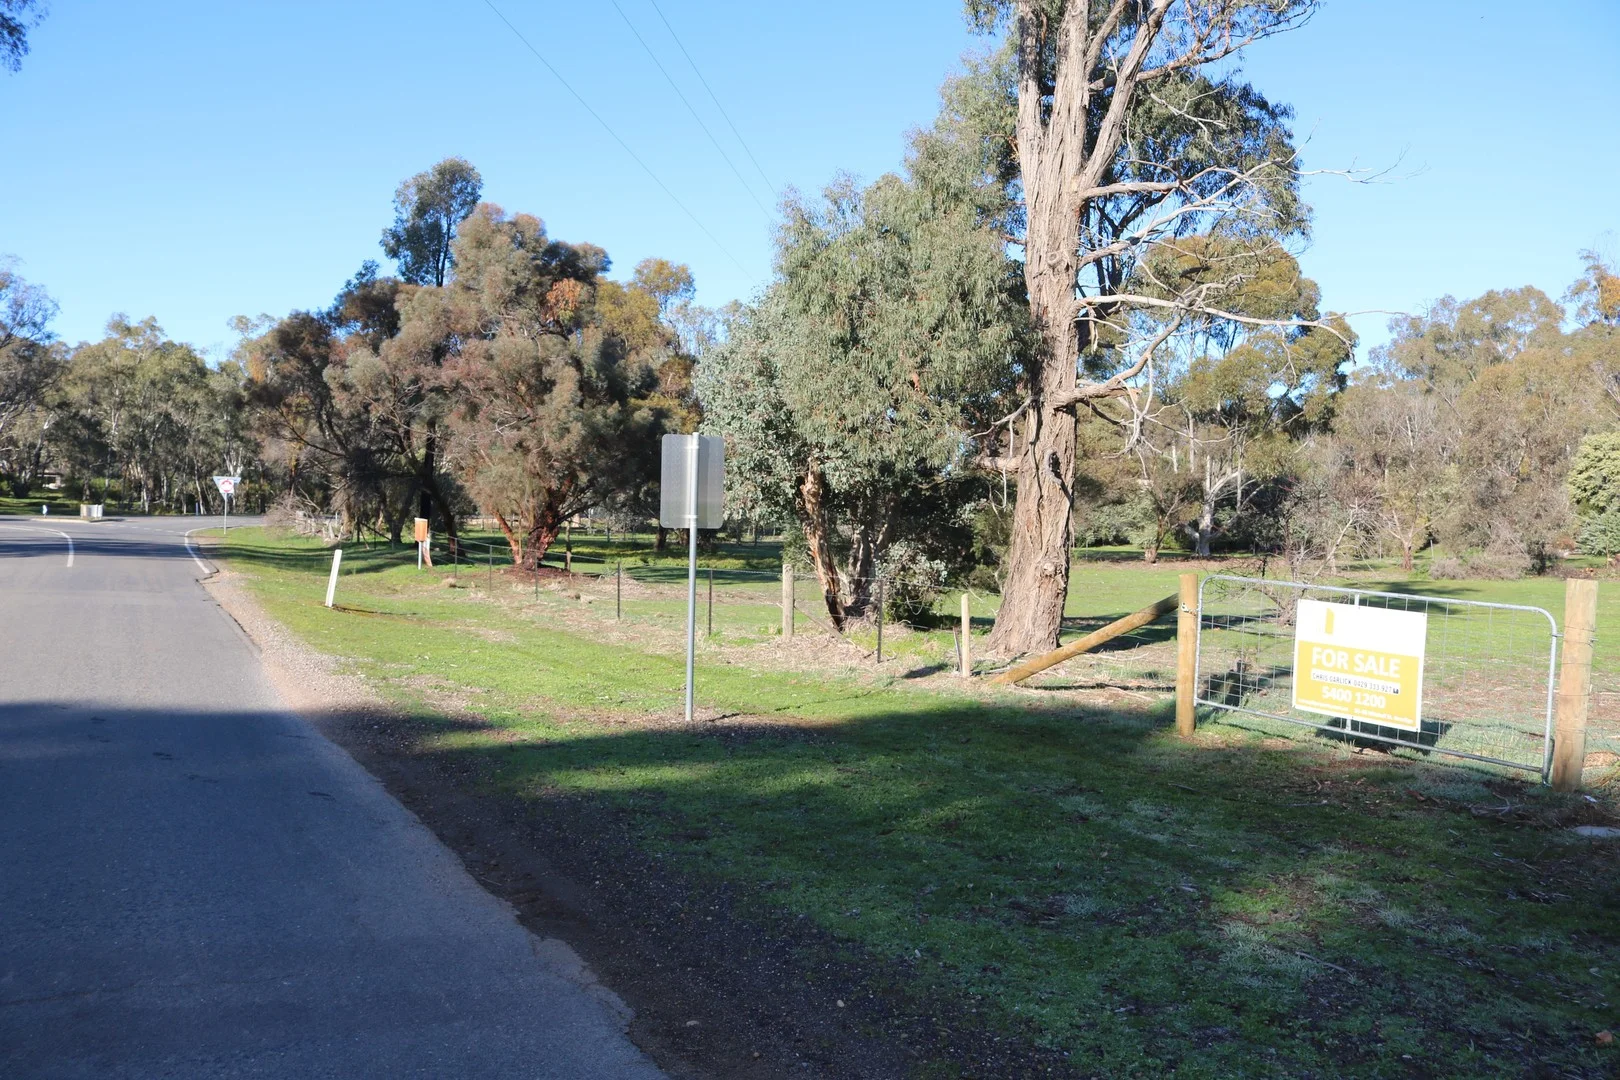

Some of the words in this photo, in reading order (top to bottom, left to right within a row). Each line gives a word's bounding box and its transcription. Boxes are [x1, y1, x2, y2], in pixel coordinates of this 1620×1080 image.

[1312, 646, 1349, 670] FOR
[1353, 653, 1401, 678] SALE
[1321, 686, 1353, 703] 5400
[1354, 692, 1387, 709] 1200
